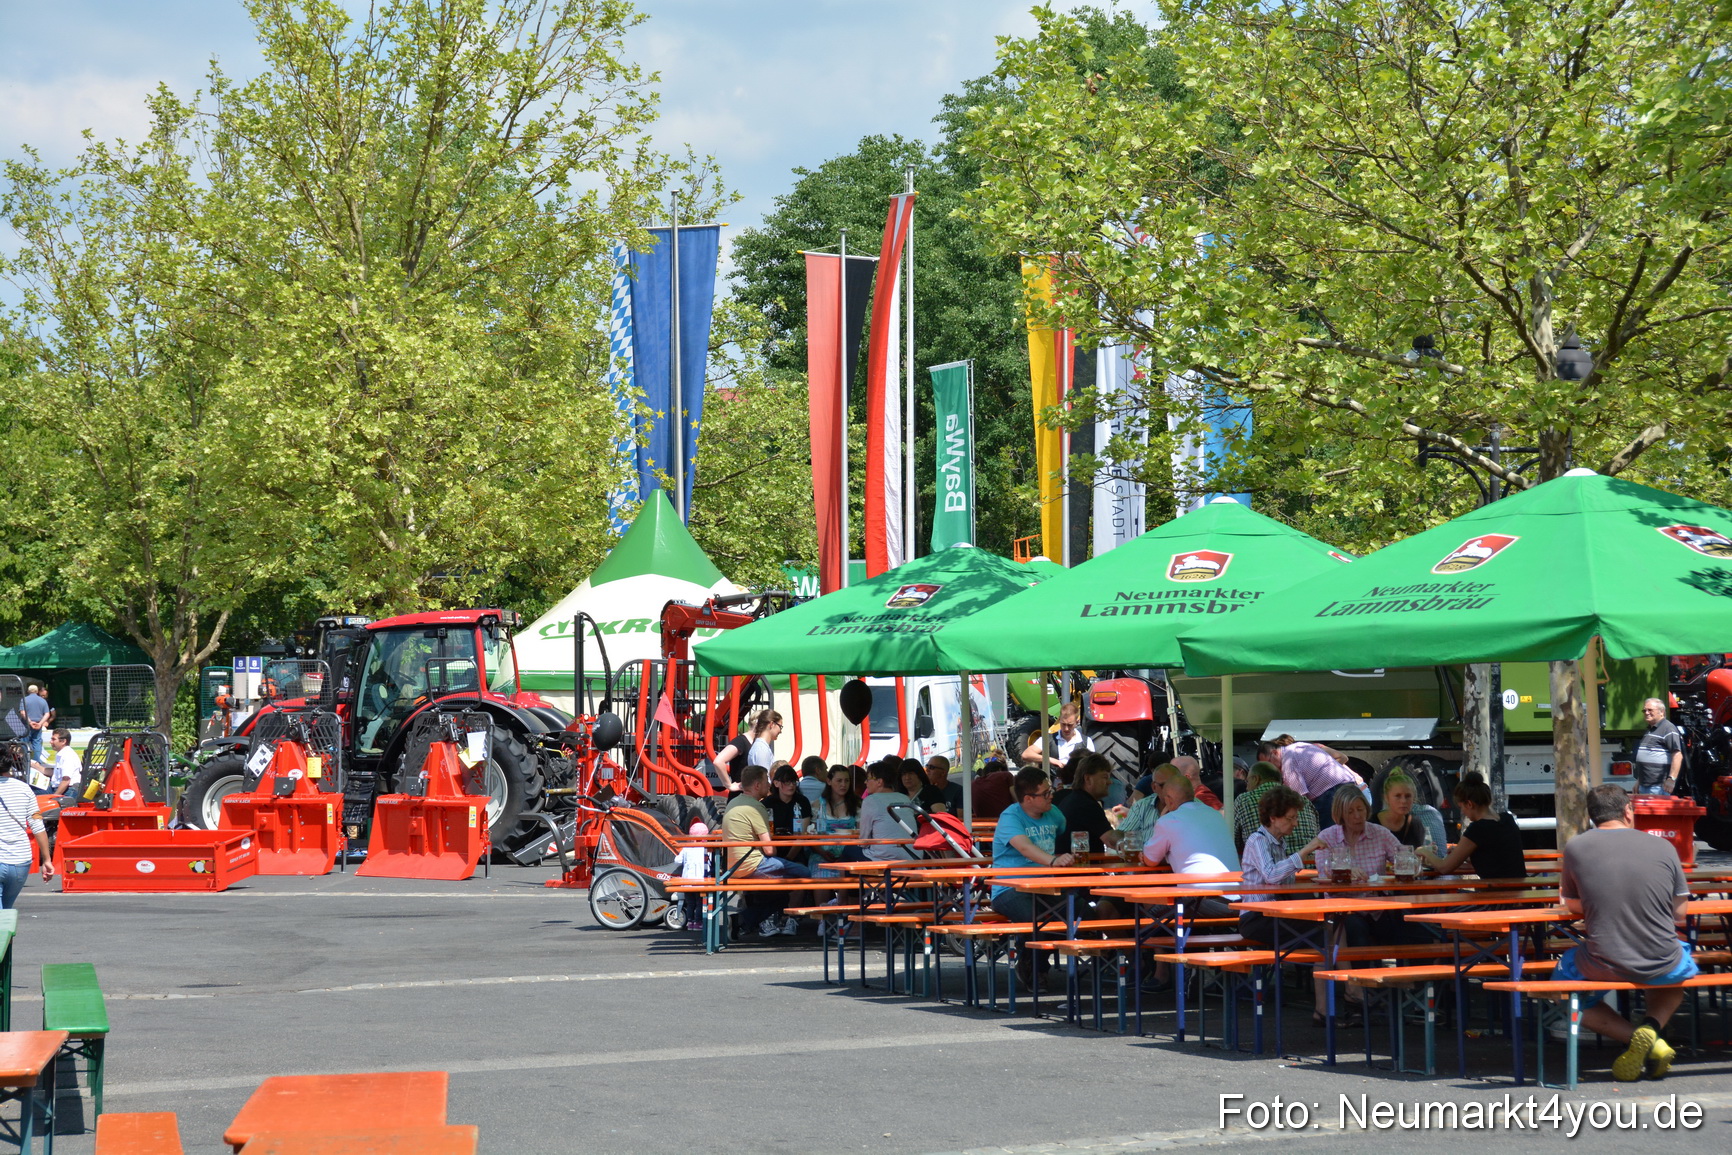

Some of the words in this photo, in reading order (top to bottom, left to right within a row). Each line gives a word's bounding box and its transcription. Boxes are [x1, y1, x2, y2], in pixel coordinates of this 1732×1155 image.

[1111, 485, 1126, 539] STADT
[1114, 587, 1265, 602] Neumarkter
[1362, 580, 1496, 598] Neumarkter
[1080, 600, 1255, 618] Lammsbr
[1314, 594, 1496, 618] Lammsbräu
[839, 613, 947, 623] Neumarkter
[1505, 694, 1516, 705] 40
